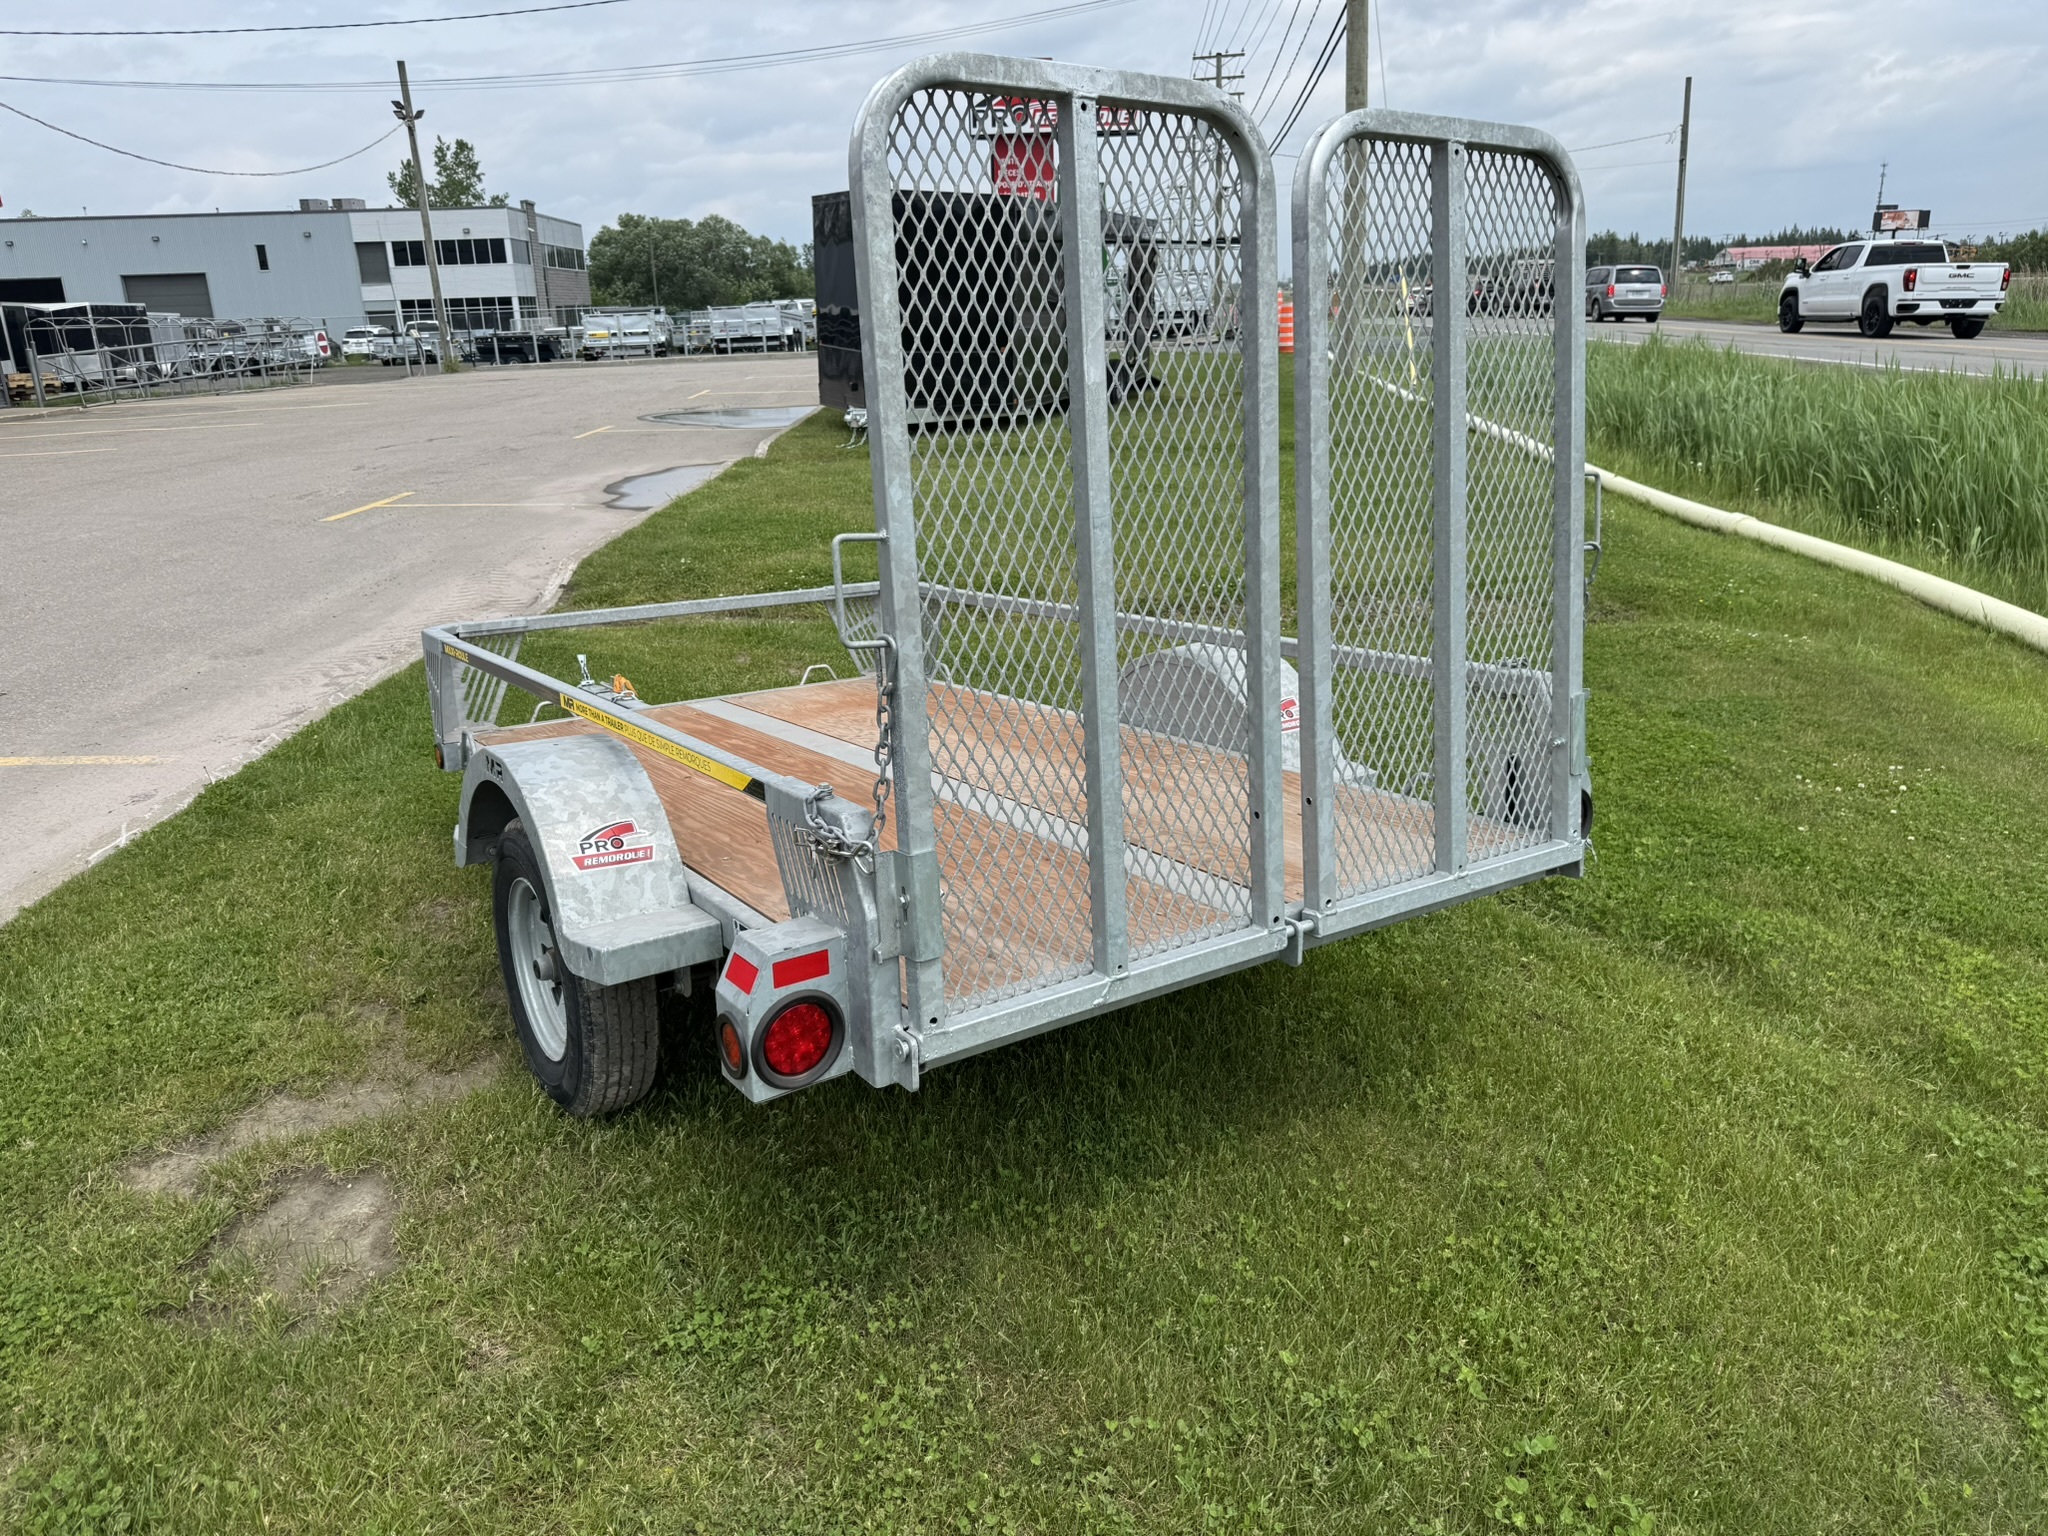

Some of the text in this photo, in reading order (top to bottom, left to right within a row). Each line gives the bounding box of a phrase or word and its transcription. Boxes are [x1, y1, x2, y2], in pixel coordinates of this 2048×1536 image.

[575, 703, 588, 715] MORE
[588, 708, 600, 721] THAN
[604, 716, 624, 732] TRAILER
[624, 725, 637, 738] PLUS
[637, 731, 647, 743] QUE
[656, 739, 675, 755] SIMPLE
[675, 748, 711, 772] REMORQUES
[579, 838, 624, 854] PRO
